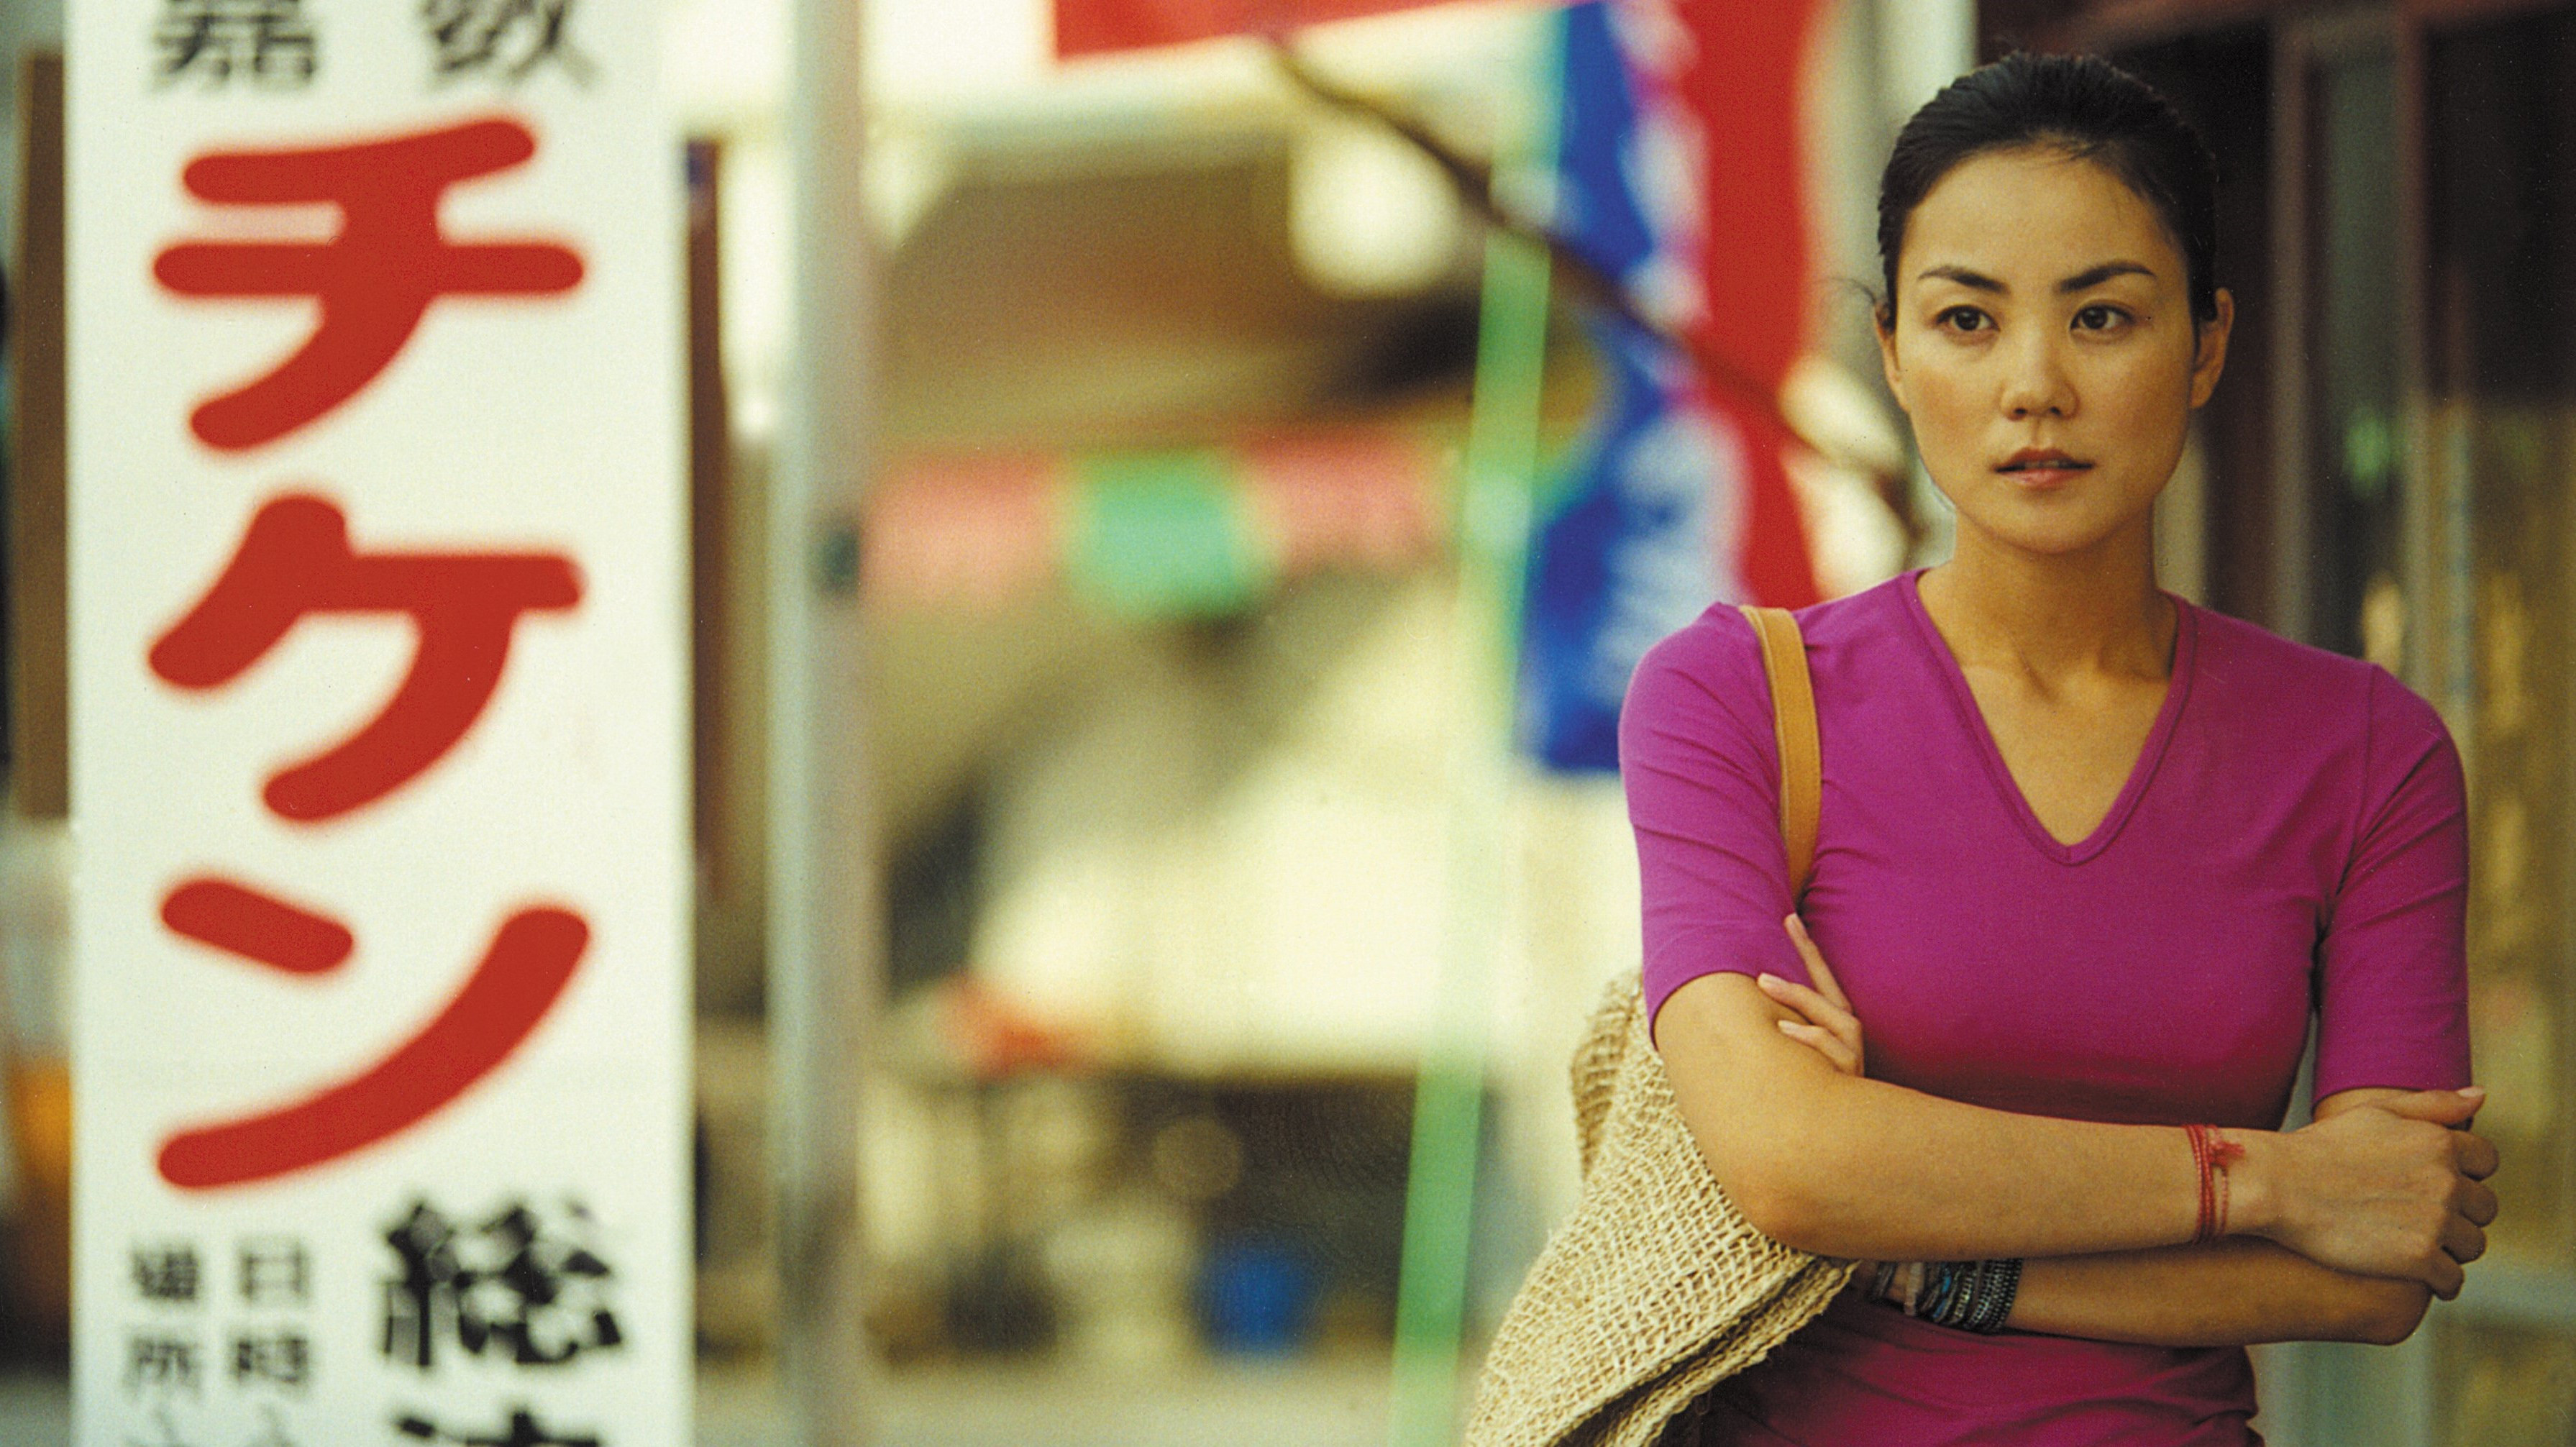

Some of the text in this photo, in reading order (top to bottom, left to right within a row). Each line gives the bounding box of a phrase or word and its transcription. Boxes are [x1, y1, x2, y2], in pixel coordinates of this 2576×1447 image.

[148, 118, 589, 1188] チケン
[128, 1241, 200, 1447] 場所
[232, 1241, 309, 1447] 日時
[381, 1197, 626, 1447] 総
